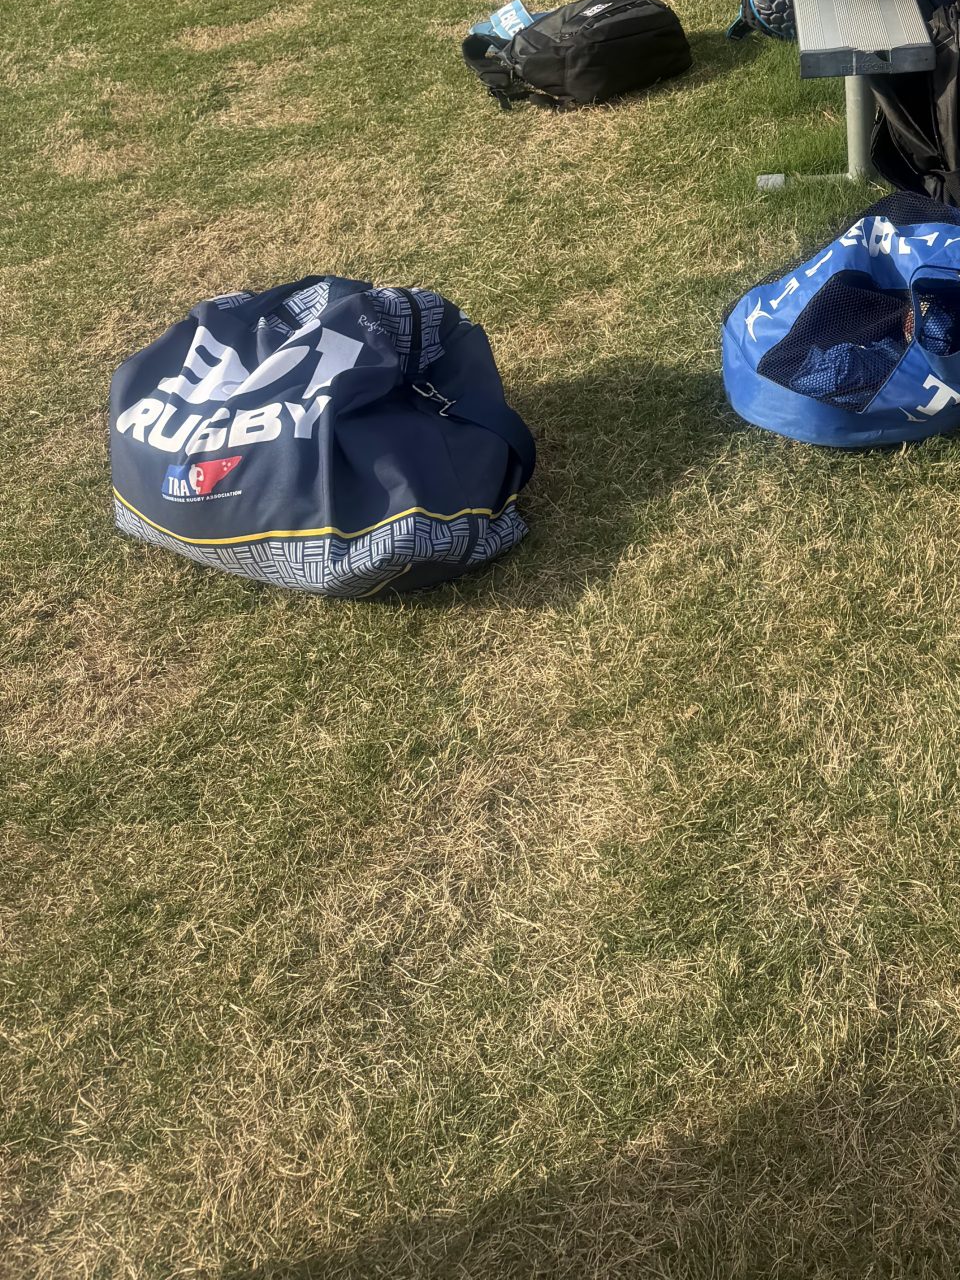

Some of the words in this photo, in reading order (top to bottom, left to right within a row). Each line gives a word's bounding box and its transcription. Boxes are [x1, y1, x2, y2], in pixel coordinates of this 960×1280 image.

[116, 395, 332, 457] RUGBY
[167, 476, 191, 497] TRA
[205, 489, 243, 501] ASSOCIATION
